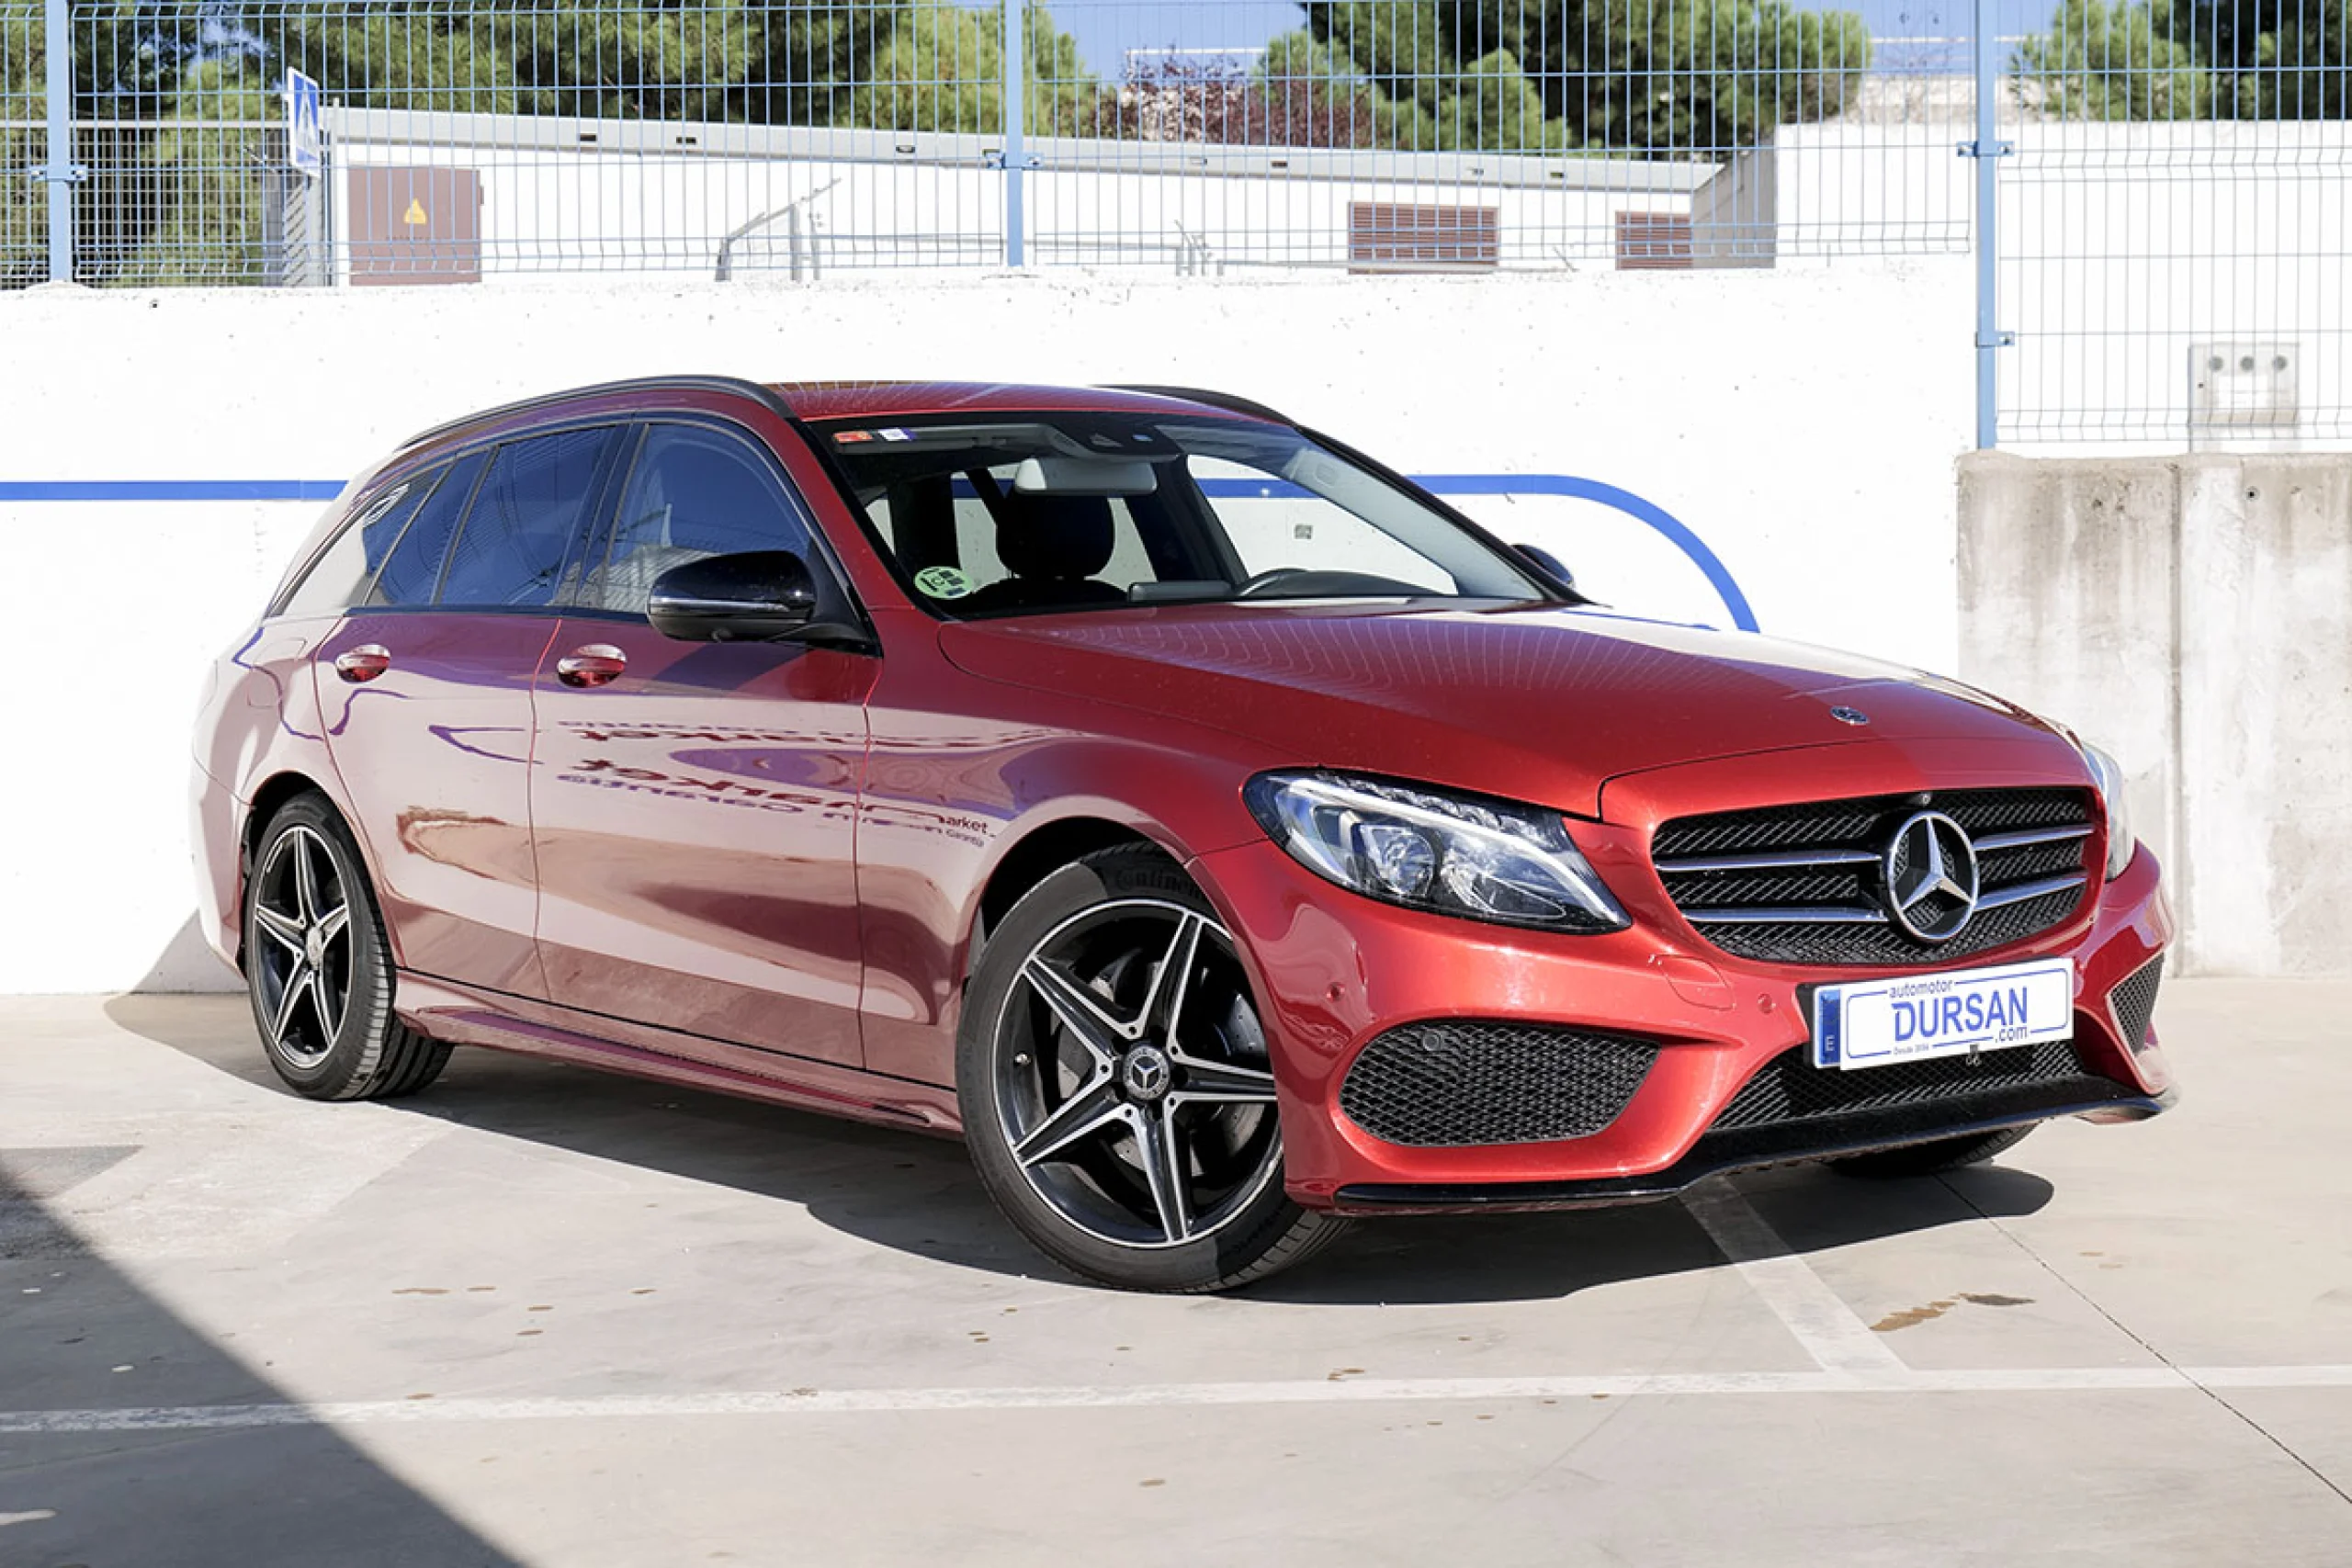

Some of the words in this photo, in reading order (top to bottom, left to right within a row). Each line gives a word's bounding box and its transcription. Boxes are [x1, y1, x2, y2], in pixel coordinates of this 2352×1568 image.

[1889, 980, 1953, 998] automotor
[1891, 986, 2028, 1042] DURSAN
[1825, 1034, 1836, 1052] E
[1995, 1026, 2028, 1043] .com
